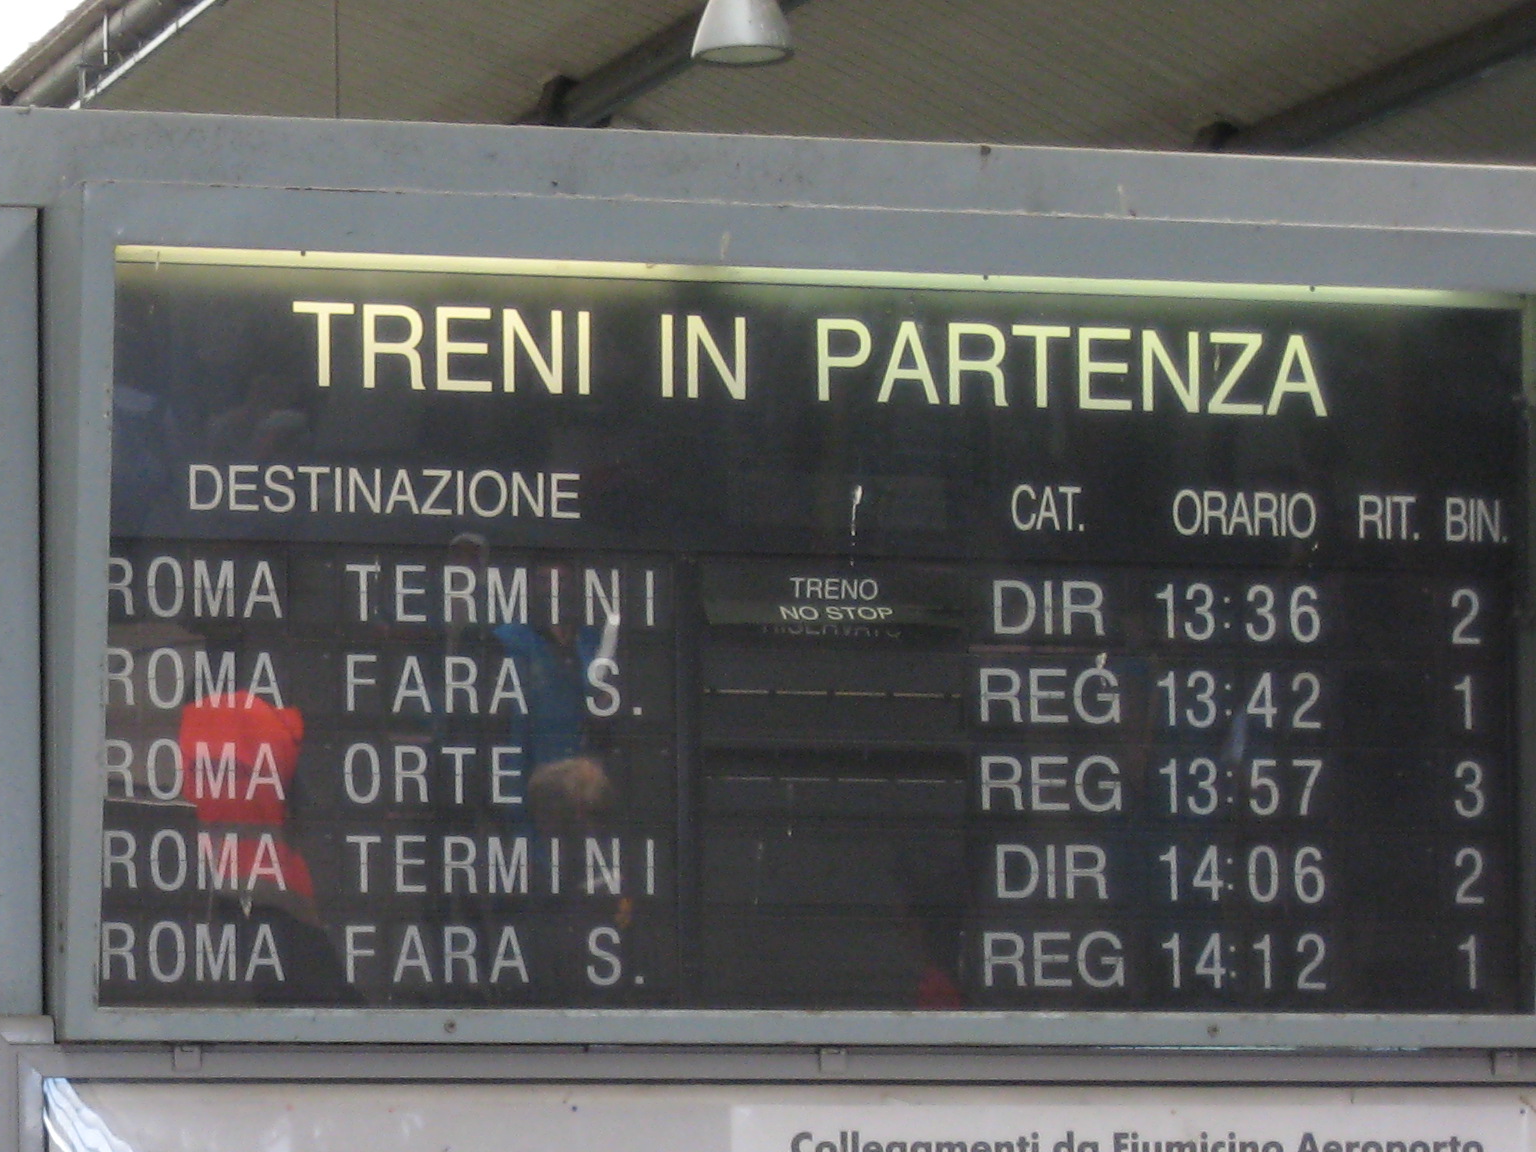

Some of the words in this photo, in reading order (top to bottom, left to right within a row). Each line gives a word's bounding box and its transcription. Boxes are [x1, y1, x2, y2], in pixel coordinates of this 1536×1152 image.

[293, 300, 590, 395] TRENI
[661, 314, 747, 400] IN
[816, 317, 1327, 417] PARTENZA
[188, 464, 581, 519] DESTINAZIONE
[1011, 484, 1084, 532] CAT.
[1173, 489, 1316, 539] ORARIO
[1358, 495, 1420, 540] RIT.
[1446, 497, 1508, 543] BIN.
[107, 556, 282, 619] ROMA
[346, 564, 655, 626] TERMINI
[993, 580, 1105, 635] DIR
[1156, 582, 1321, 643] 13:36
[1451, 588, 1481, 644] 2
[779, 606, 818, 620] NO
[826, 606, 893, 620] STOP
[790, 577, 879, 600] TRENO
[106, 647, 283, 709] ROMA
[347, 655, 528, 714] FARA
[586, 657, 643, 716] S.
[980, 667, 1121, 725] REG
[1156, 670, 1323, 728] 13:42
[1454, 675, 1473, 729] 1
[105, 739, 285, 801] ROMA
[344, 742, 523, 804] ORTE
[981, 755, 1122, 812] REG
[1159, 758, 1324, 815] 13:57
[1454, 761, 1485, 818] 3
[103, 829, 287, 891] ROMA
[346, 836, 655, 895] TERMINI
[995, 843, 1109, 900] DIR
[1159, 845, 1326, 903] 14:06
[1455, 847, 1484, 904] 2
[102, 920, 285, 982] ROMA
[347, 925, 529, 983] FARA
[587, 927, 644, 986] S.
[983, 931, 1124, 987] REG
[1162, 932, 1327, 990] 14:12
[1458, 934, 1477, 989] 1
